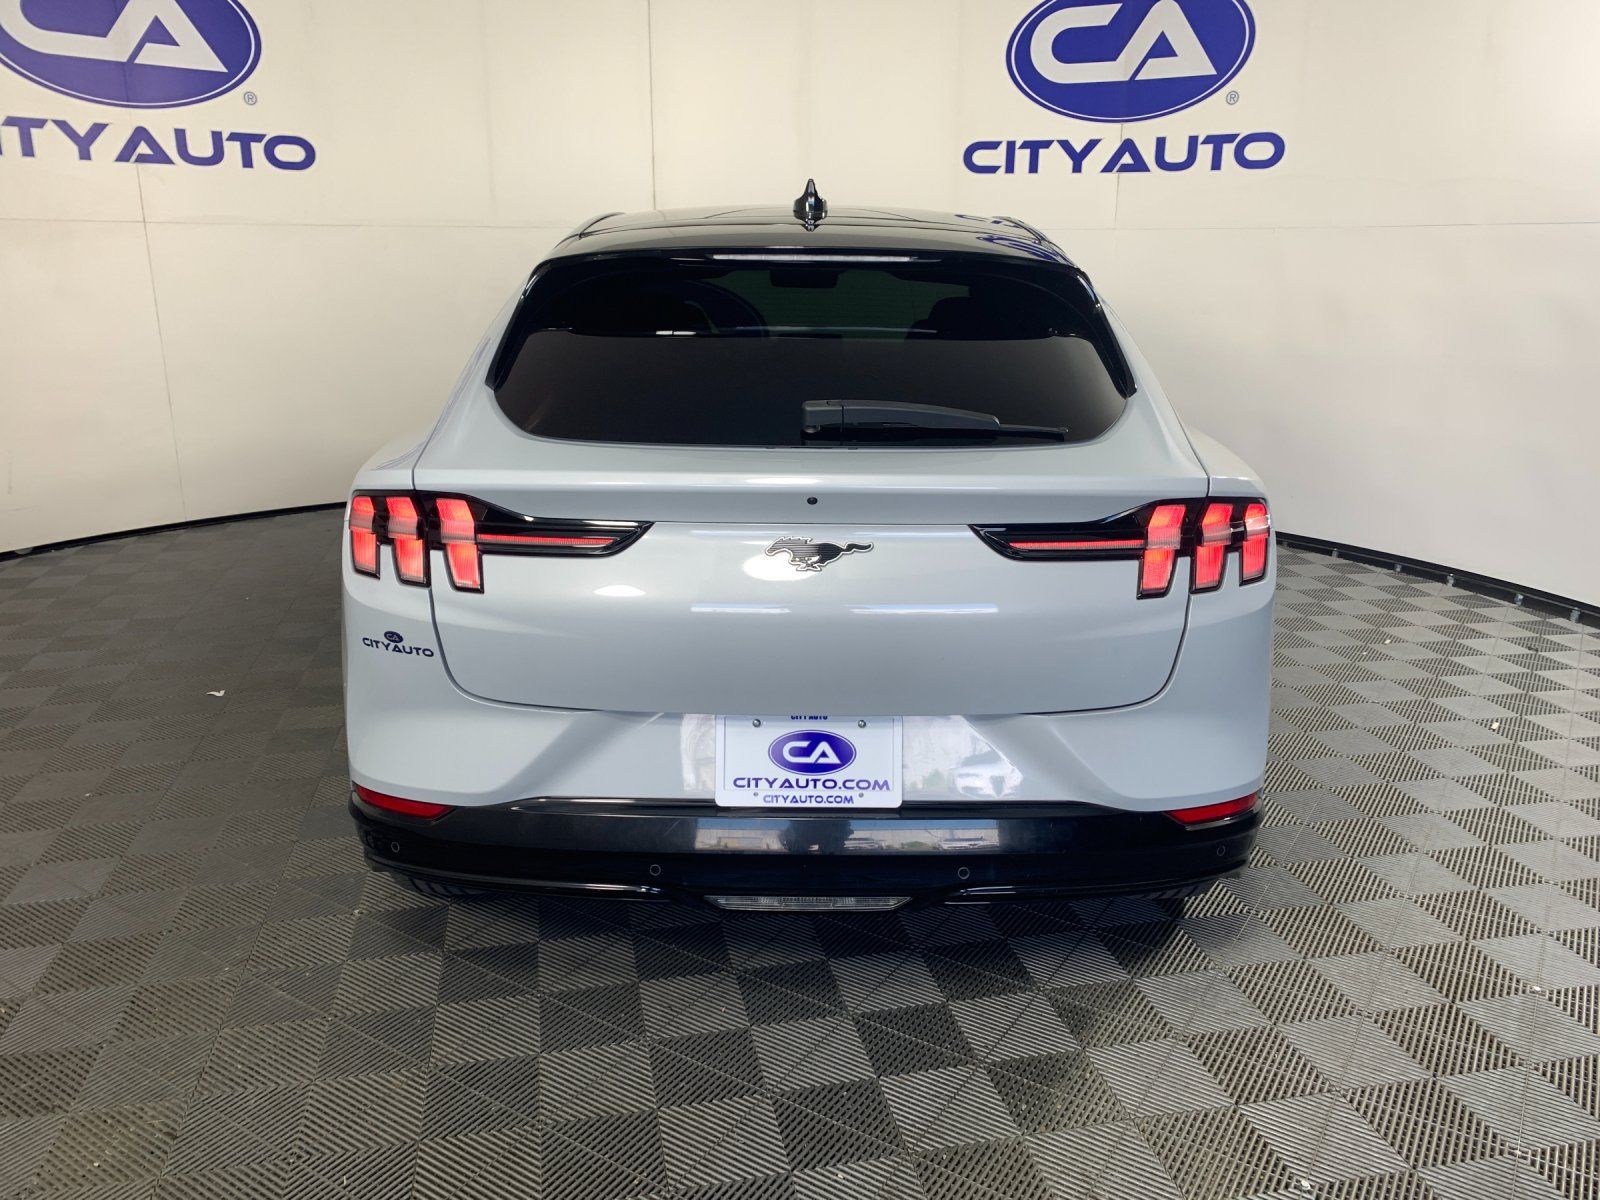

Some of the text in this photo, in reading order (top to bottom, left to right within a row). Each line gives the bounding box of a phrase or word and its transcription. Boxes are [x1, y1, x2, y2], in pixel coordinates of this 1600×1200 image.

[1030, 0, 1217, 84] CA
[0, 116, 316, 171] TYAUTO
[362, 637, 434, 657] CITYAUTO
[783, 741, 841, 764] CA
[733, 777, 890, 790] CITYAUTO.COM
[763, 794, 854, 804] CITYAUTO.COM
